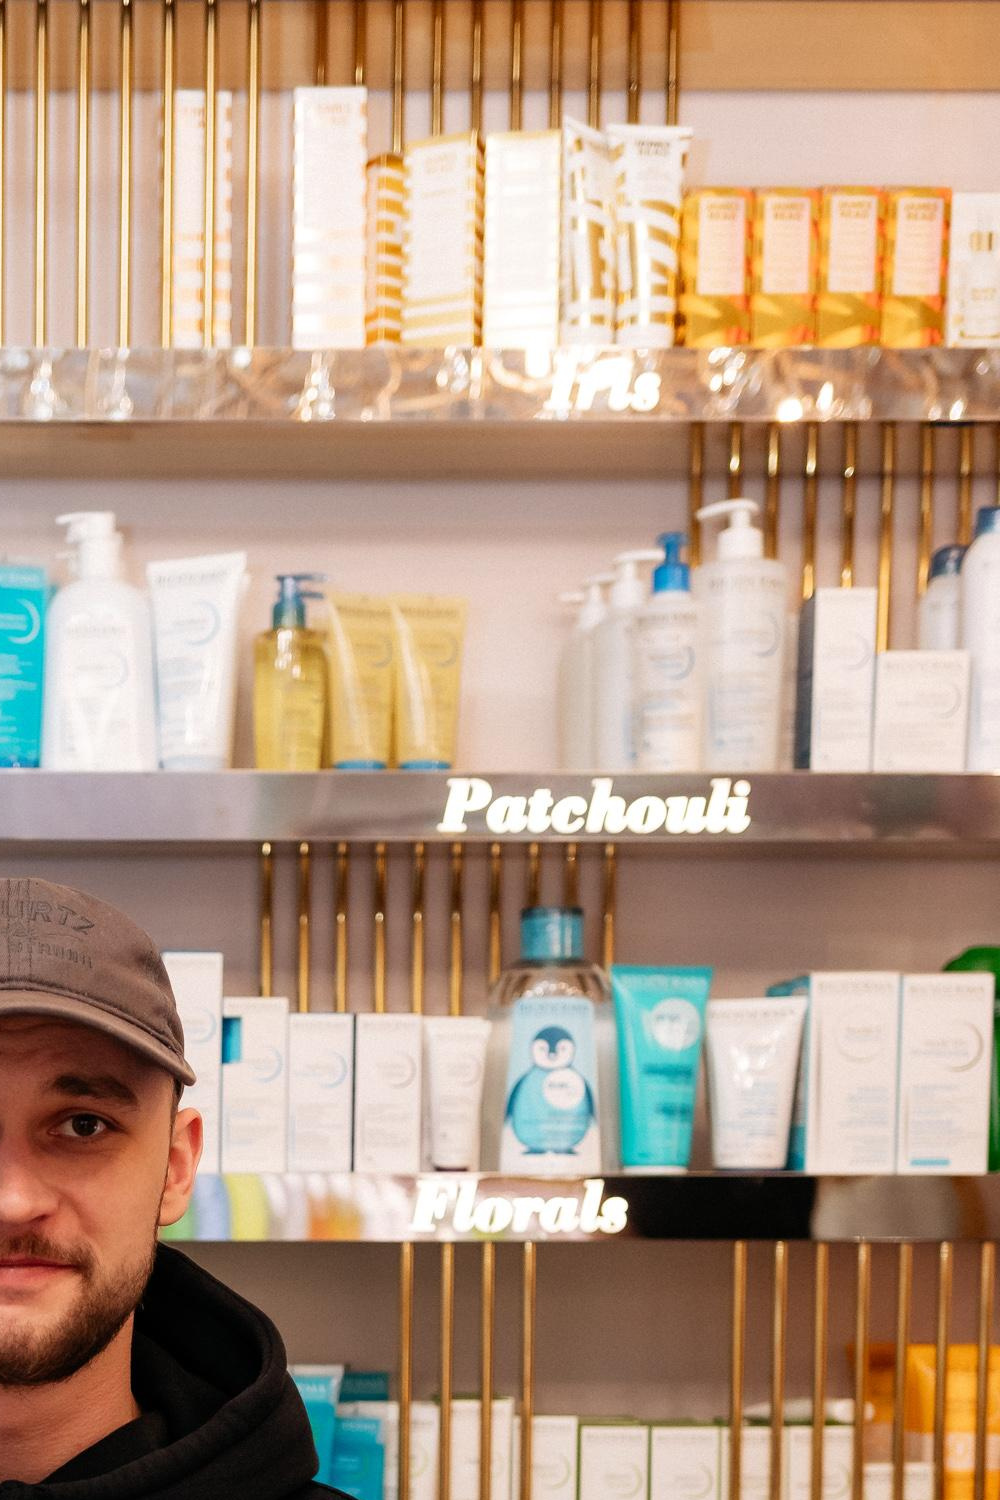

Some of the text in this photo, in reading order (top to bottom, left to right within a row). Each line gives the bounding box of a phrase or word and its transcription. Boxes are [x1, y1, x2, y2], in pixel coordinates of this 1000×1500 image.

[543, 346, 661, 412] Iris
[437, 777, 752, 834] Patchouli
[410, 1178, 629, 1234] Florals
